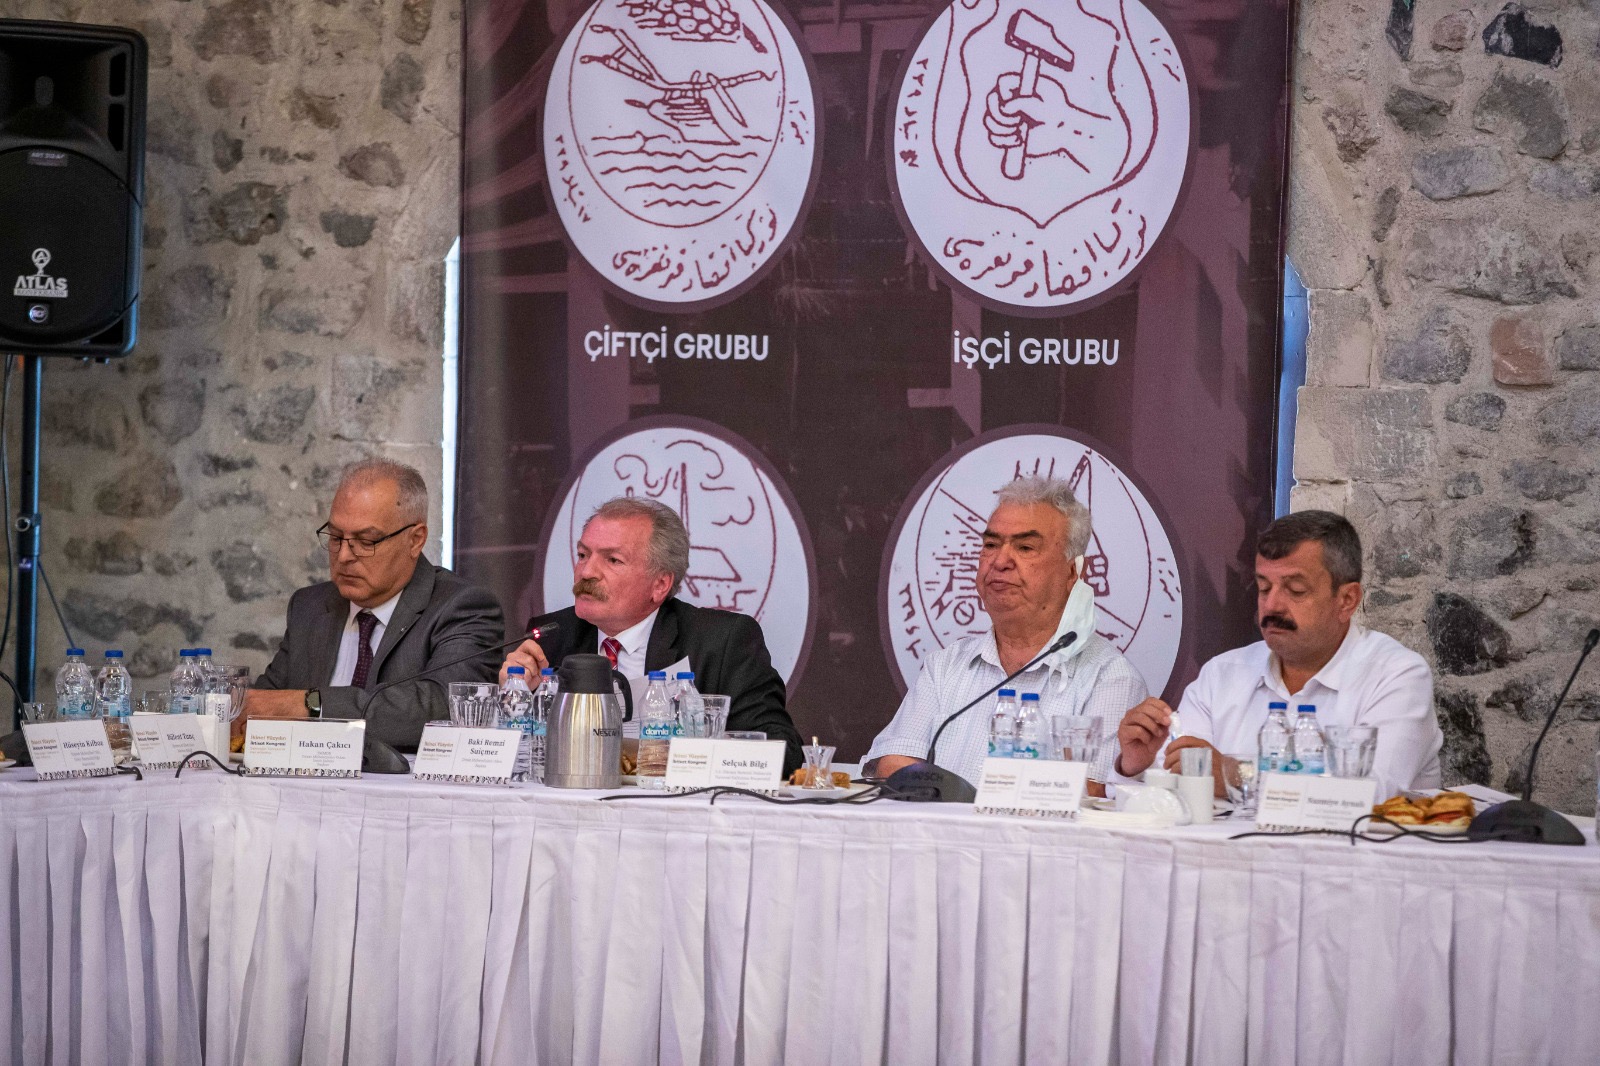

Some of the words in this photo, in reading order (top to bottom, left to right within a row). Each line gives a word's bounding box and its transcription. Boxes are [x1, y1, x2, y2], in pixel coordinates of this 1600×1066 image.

[14, 275, 68, 291] ATLAS
[584, 324, 668, 363] ÇİFTÇİ
[673, 331, 769, 362] GRUBU
[953, 330, 1011, 370] İŞÇİ
[1018, 338, 1120, 366] GRUBU
[645, 728, 669, 736] damla
[299, 740, 324, 748] Hakan
[326, 740, 351, 750] Çakıcı
[468, 738, 484, 747] Baki
[484, 739, 506, 747] Remzi
[469, 747, 499, 757] Suiçmez
[721, 759, 748, 769] Selçuk
[749, 760, 768, 770] Bilgi
